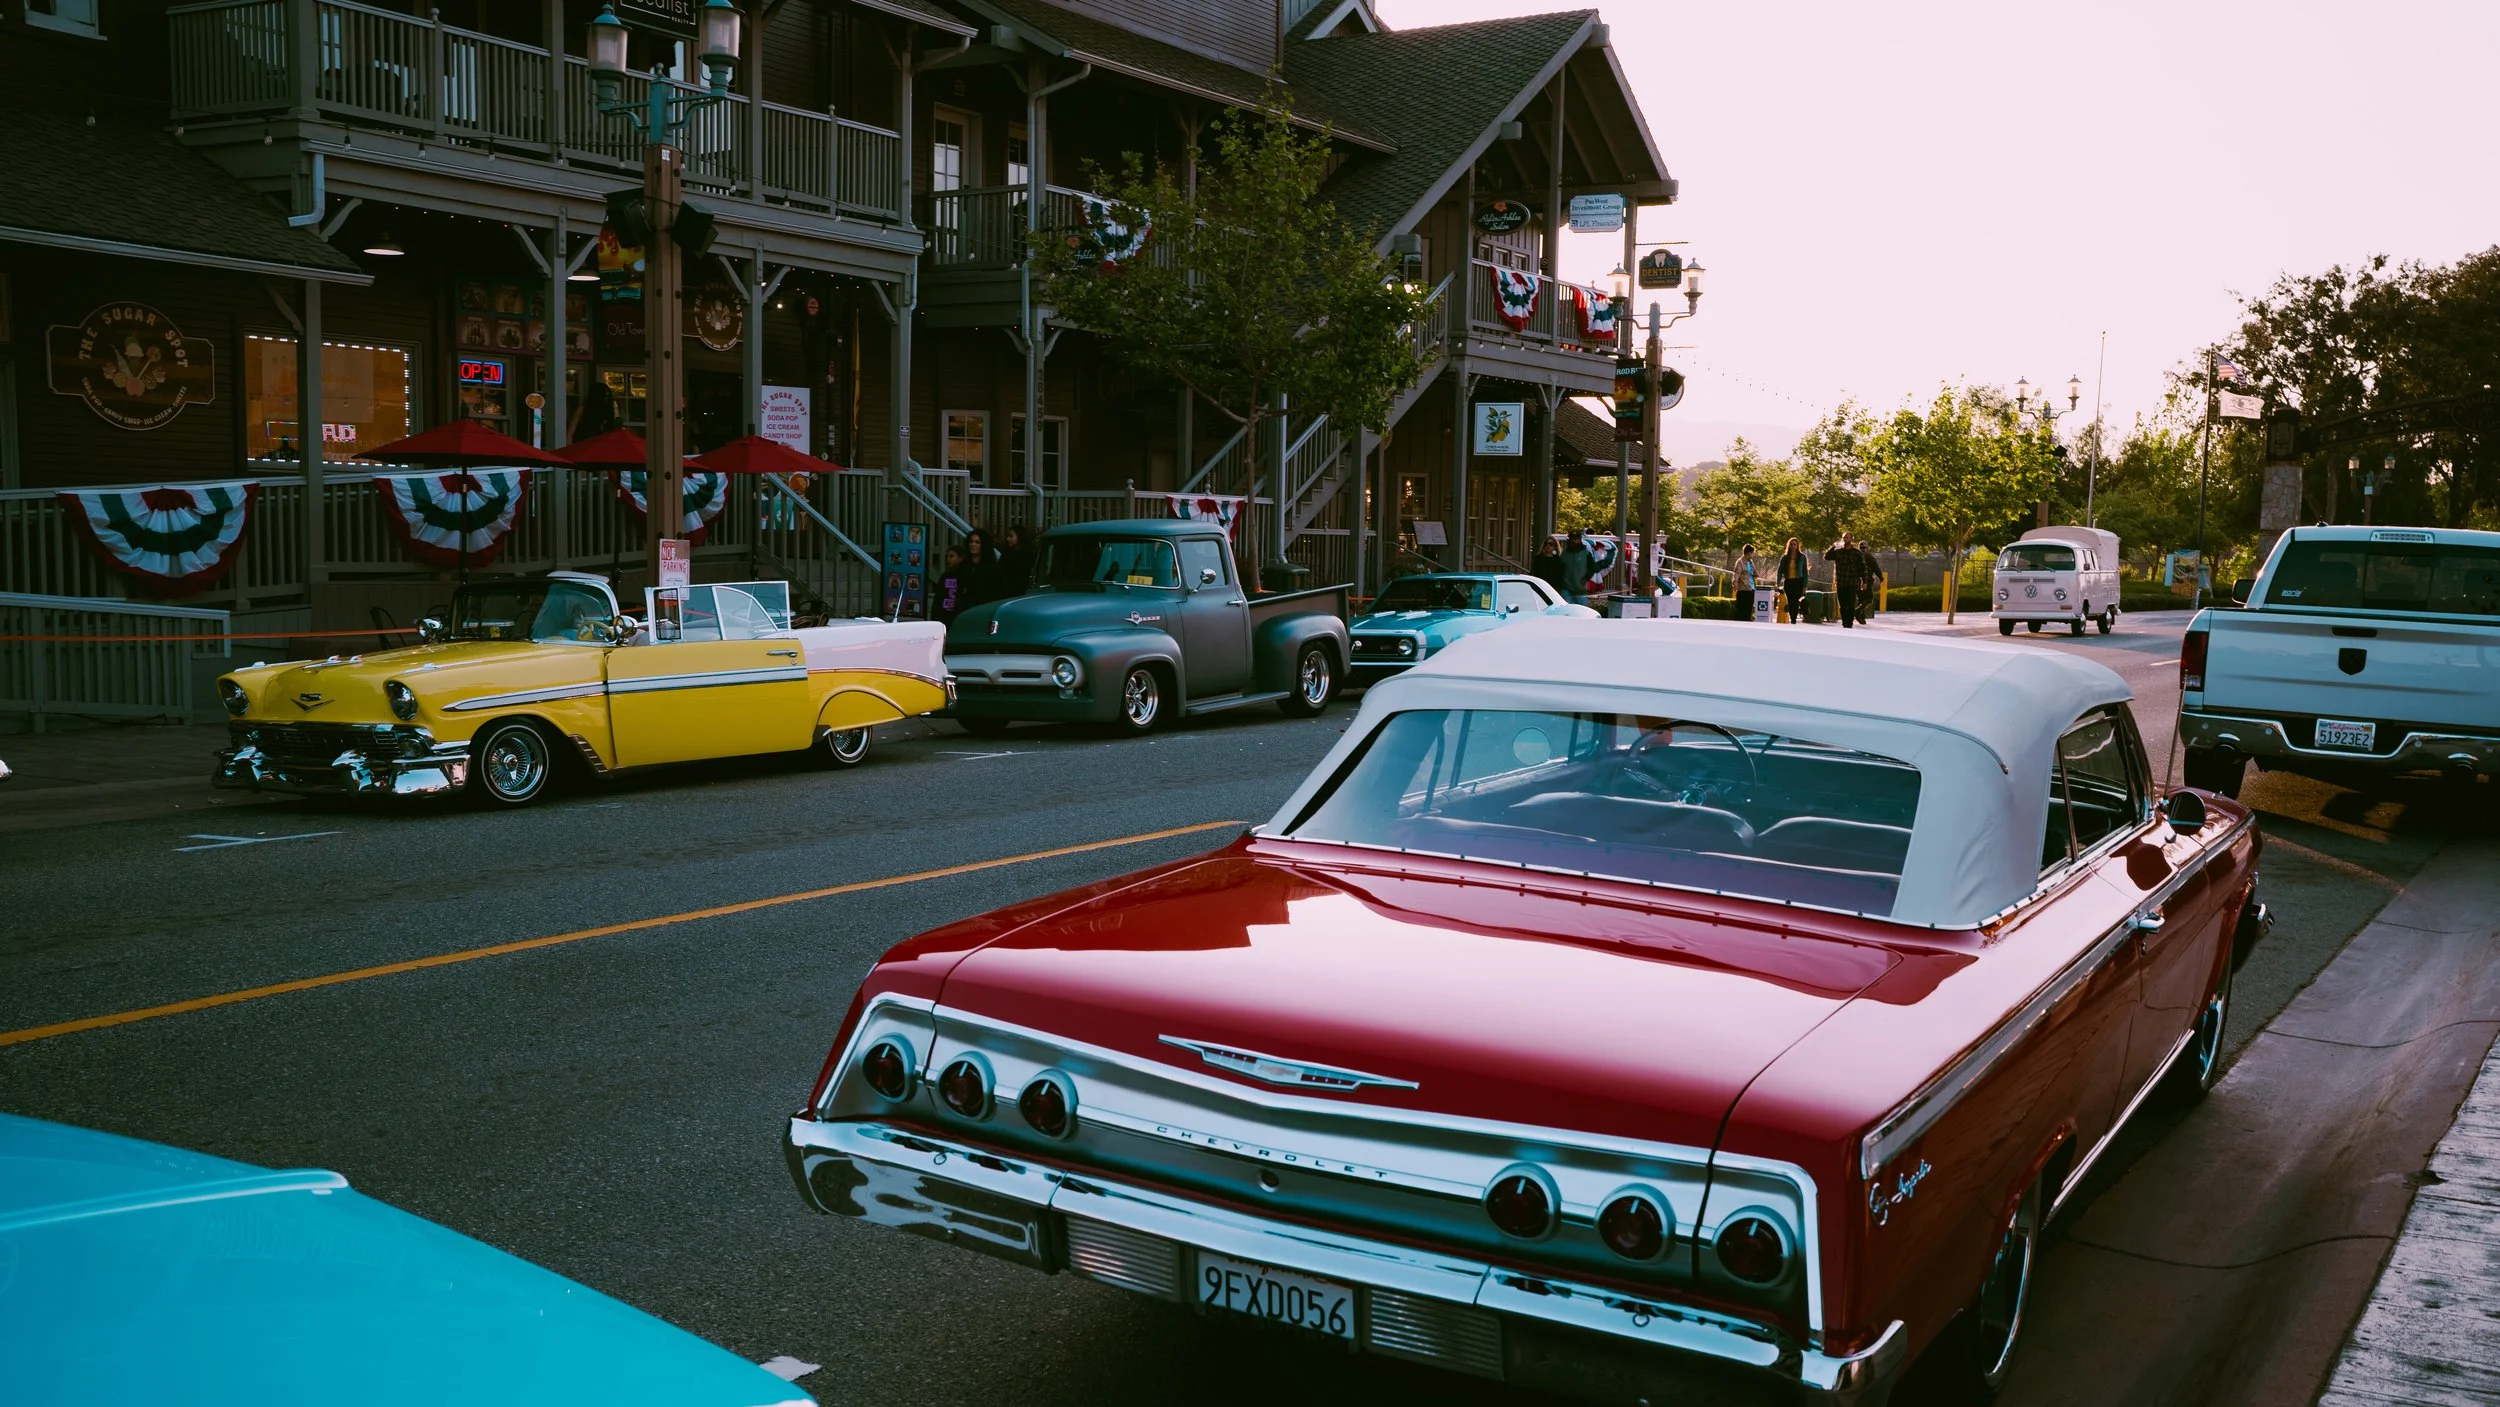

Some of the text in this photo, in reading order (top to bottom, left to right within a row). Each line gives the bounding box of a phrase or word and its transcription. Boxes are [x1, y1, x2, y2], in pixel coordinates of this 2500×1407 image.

[1591, 219, 1619, 227] Financial
[1642, 267, 1679, 277] DENTIST
[607, 321, 626, 336] Old
[78, 306, 189, 368] THE SUGAR SPOT
[460, 362, 501, 382] OPEN
[1616, 368, 1631, 376] ROD
[769, 392, 793, 401] SUGAR
[793, 398, 808, 416] SPOT
[661, 546, 672, 560] NO
[662, 561, 687, 574] PARKING
[2328, 722, 2363, 732] California
[2319, 729, 2371, 747] 51923E2
[1155, 1125, 1389, 1179] CHEVROLET
[1204, 1265, 1347, 1336] 9FXD056
